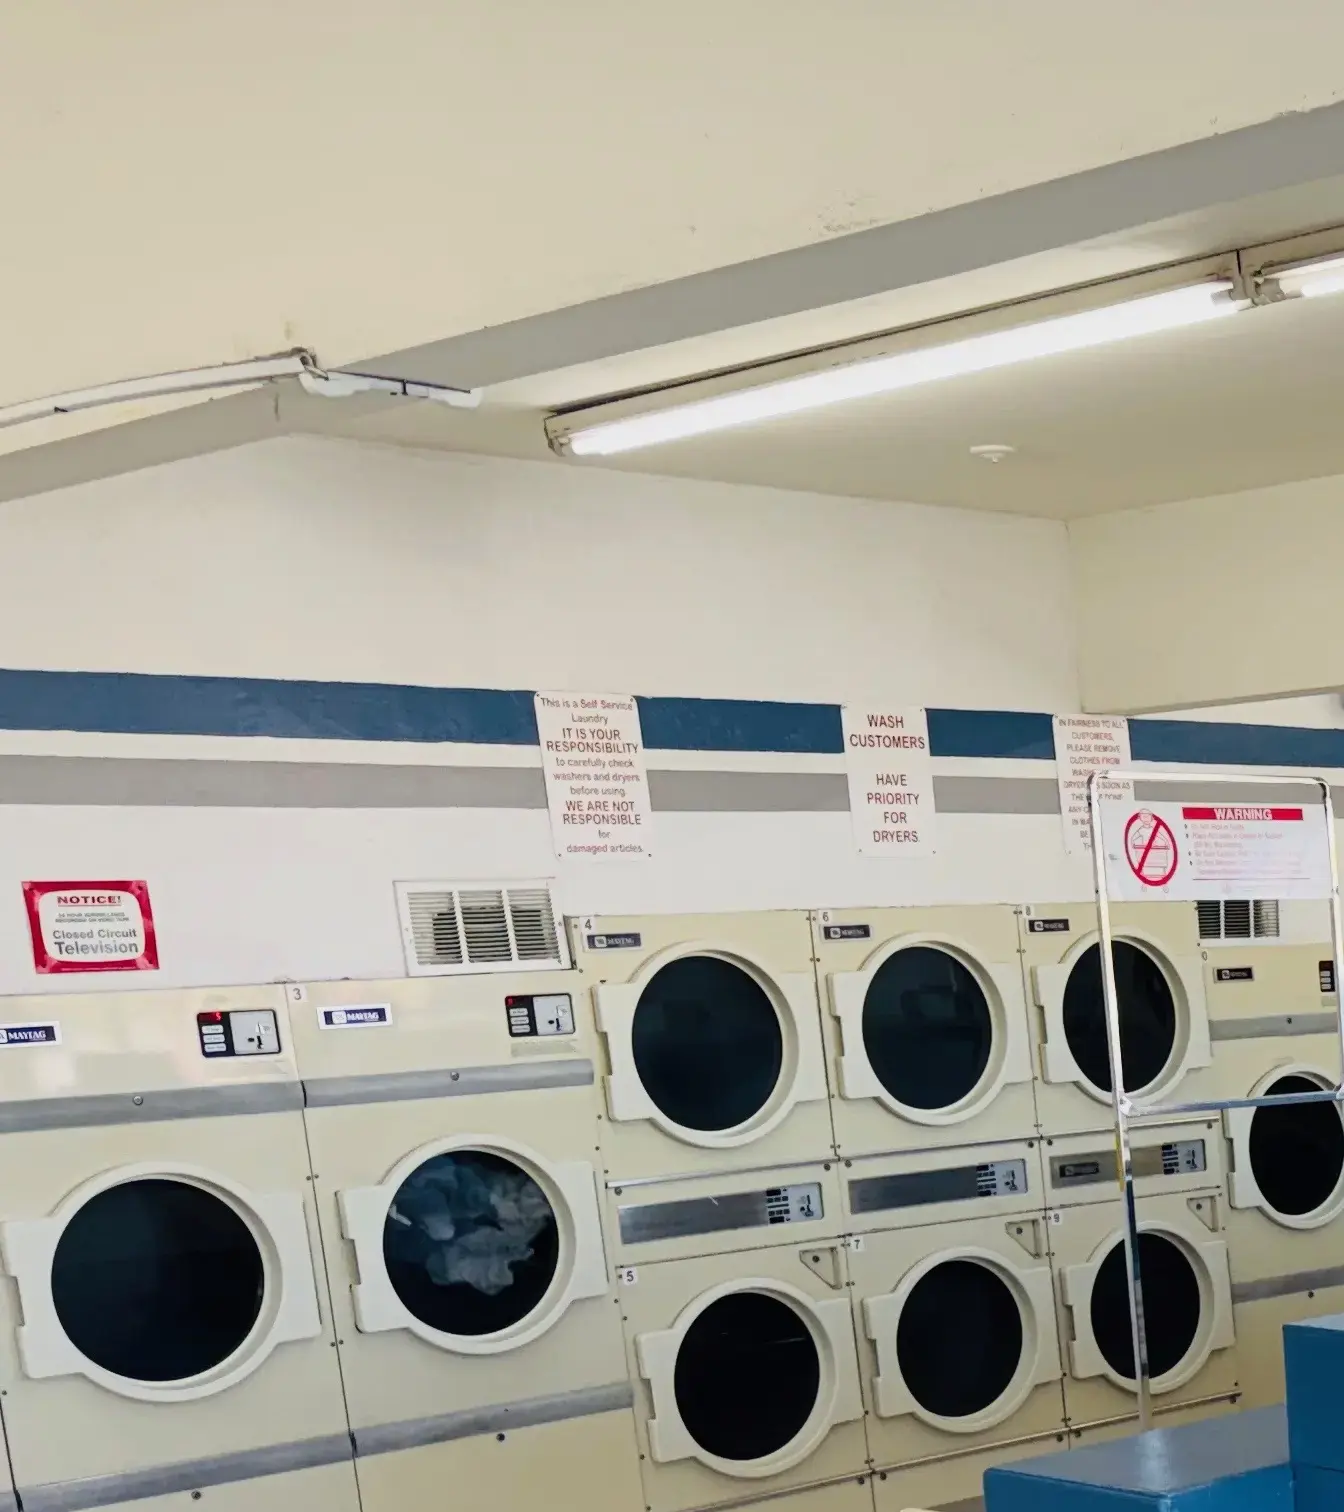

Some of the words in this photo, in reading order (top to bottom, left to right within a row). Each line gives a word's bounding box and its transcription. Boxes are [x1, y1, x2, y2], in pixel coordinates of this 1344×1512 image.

[541, 698, 560, 708] This
[580, 699, 598, 709] Self
[600, 700, 633, 711] Service
[572, 714, 608, 725] Laundry
[867, 714, 904, 729] WASH
[562, 728, 573, 739] IT
[576, 728, 586, 740] IS
[589, 729, 621, 740] YOUR
[546, 741, 639, 754] RESPONSIBILITY
[849, 733, 926, 750] CUSTOMERS
[1066, 743, 1093, 753] PLEASE
[556, 757, 565, 767] to
[567, 757, 606, 769] carefully
[608, 758, 635, 768] check
[553, 772, 591, 781] washers
[594, 773, 610, 781] and
[612, 773, 640, 784] dryers
[876, 773, 908, 787] HAVE
[570, 786, 600, 795] before
[866, 792, 920, 805] PRIORITY
[565, 800, 584, 811] WE
[587, 800, 609, 812] ARE
[612, 801, 635, 812] NOT
[563, 814, 642, 825] RESPONSIBLE
[883, 811, 908, 824] FOR
[1213, 808, 1273, 821] WARNING
[598, 830, 611, 839] for
[566, 844, 608, 855] damaged
[56, 895, 122, 904] NOTICE!
[823, 911, 829, 923] 6
[585, 918, 592, 931] 4
[52, 929, 94, 940] Closed
[97, 928, 138, 939] Circuit
[53, 940, 139, 956] Television
[293, 988, 301, 1001] 3
[8, 1029, 46, 1041] MAYTAG
[854, 1239, 861, 1250] 7
[626, 1270, 635, 1282] 5
